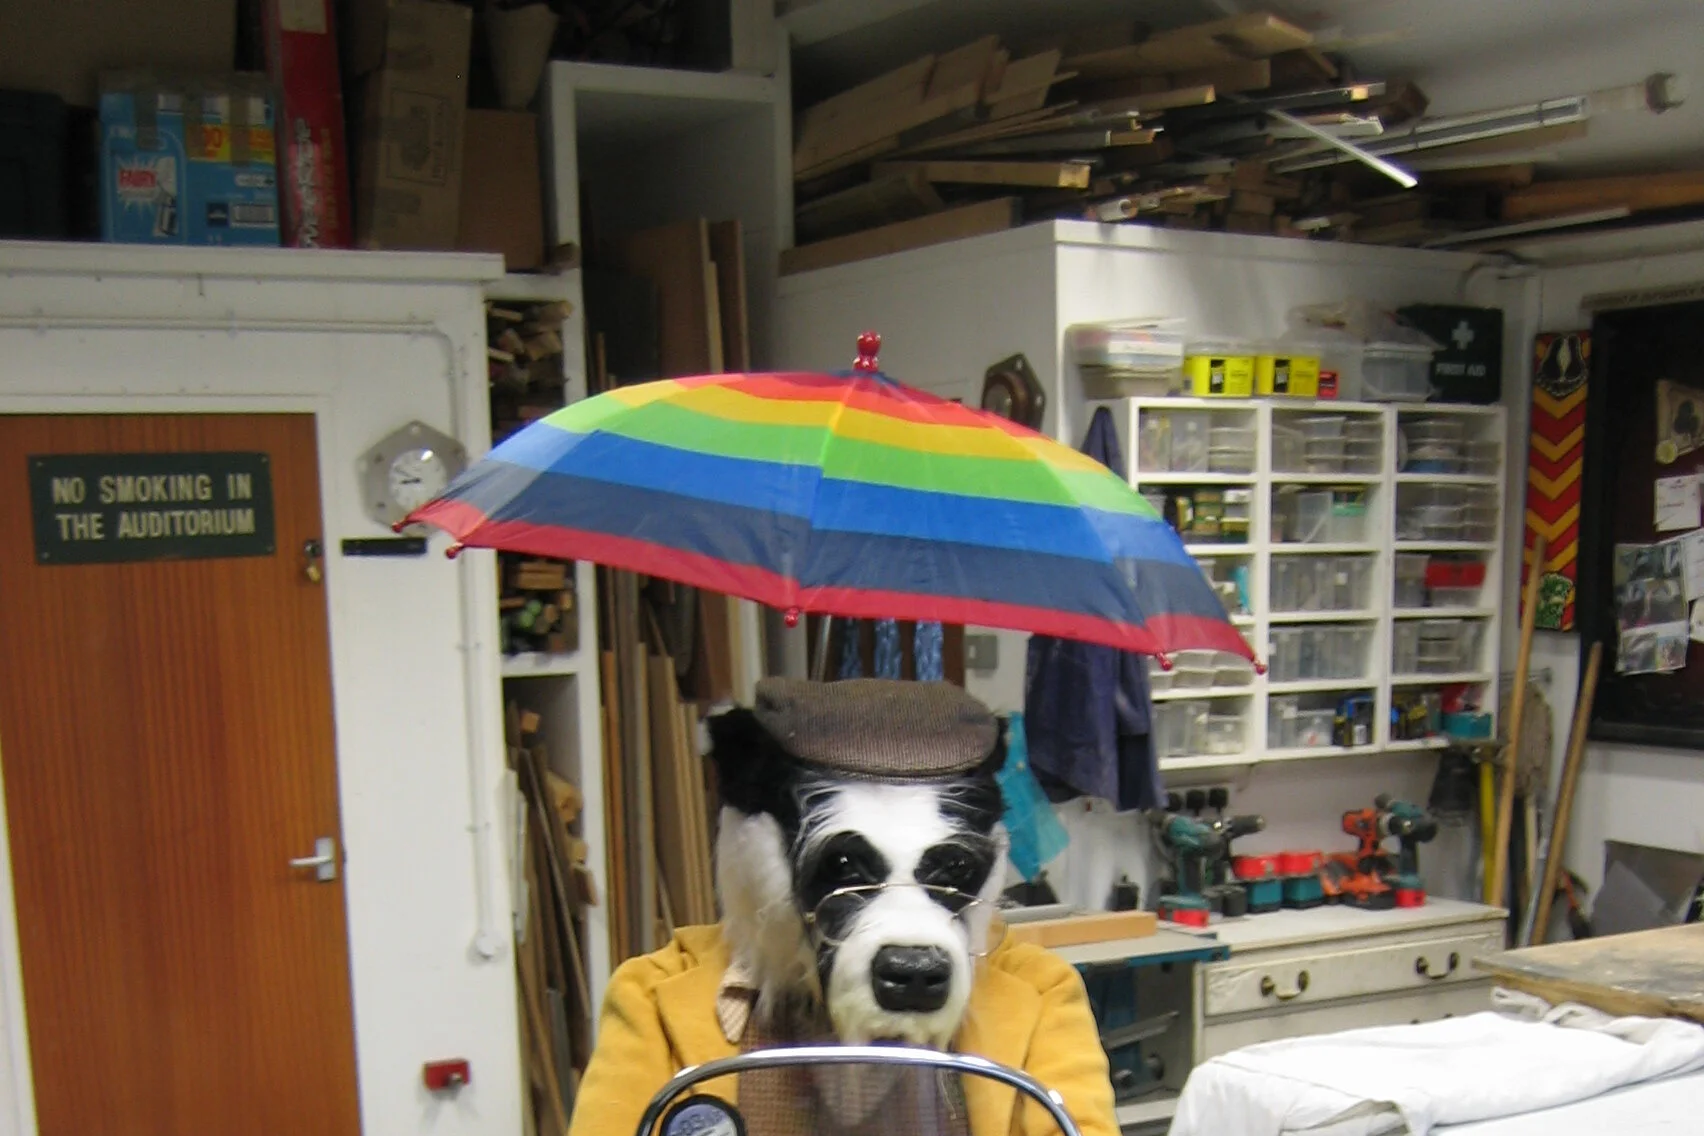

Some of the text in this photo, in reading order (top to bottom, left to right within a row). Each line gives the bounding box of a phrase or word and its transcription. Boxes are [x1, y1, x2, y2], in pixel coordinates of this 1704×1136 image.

[52, 473, 252, 504] NO SMOKING IN
[56, 507, 255, 541] THE AUDITORIUM
